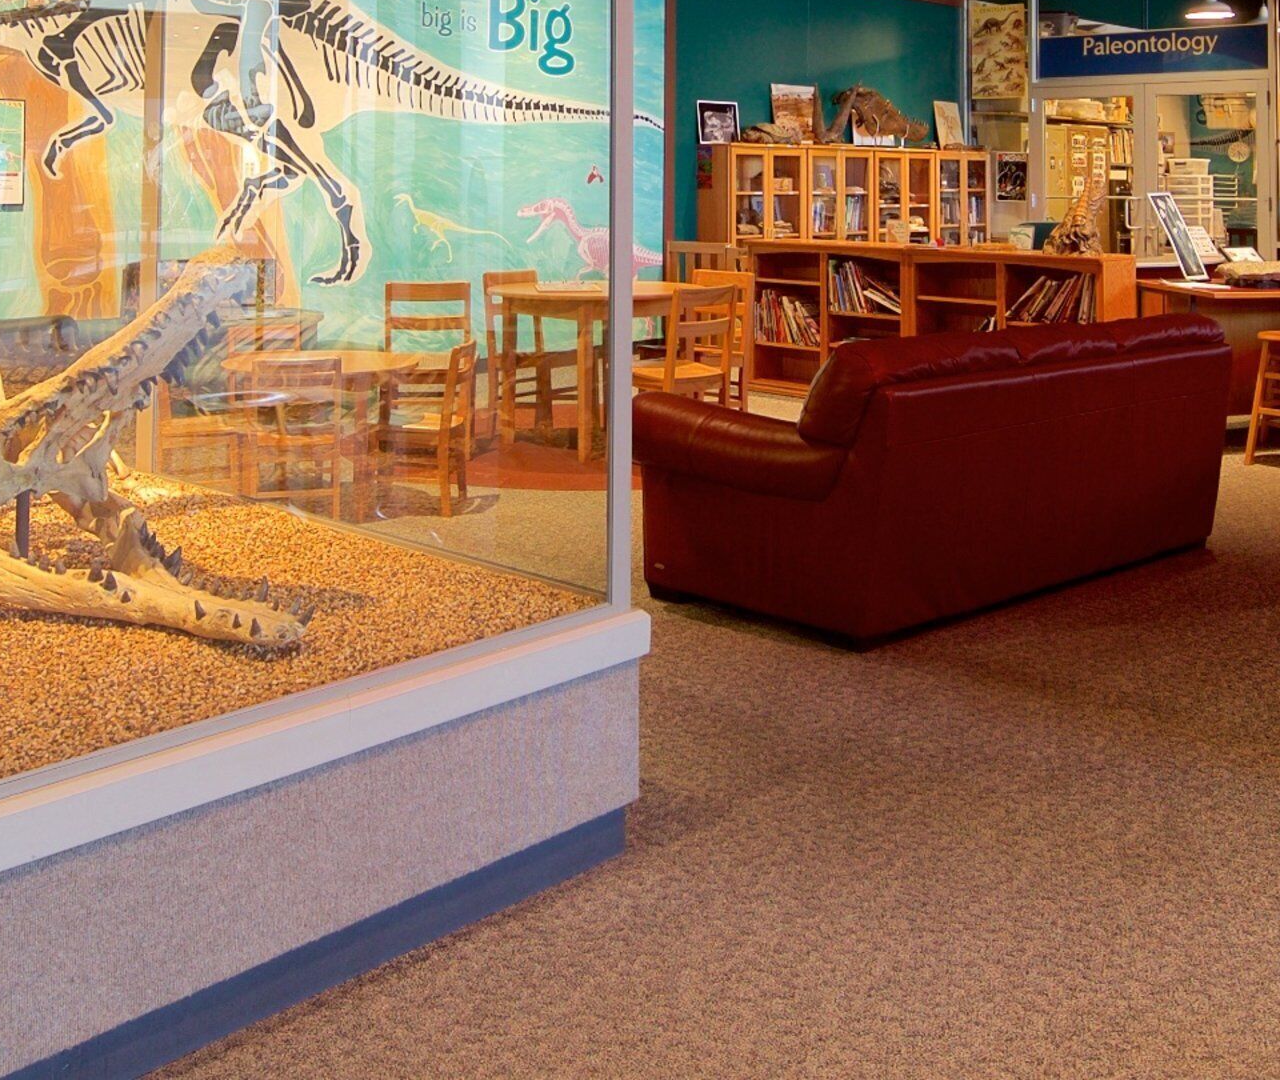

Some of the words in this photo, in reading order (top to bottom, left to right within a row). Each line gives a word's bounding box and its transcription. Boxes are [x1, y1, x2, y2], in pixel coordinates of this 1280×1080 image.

[421, 1, 453, 36] big
[460, 9, 477, 32] is
[1082, 32, 1219, 56] Paleontology
